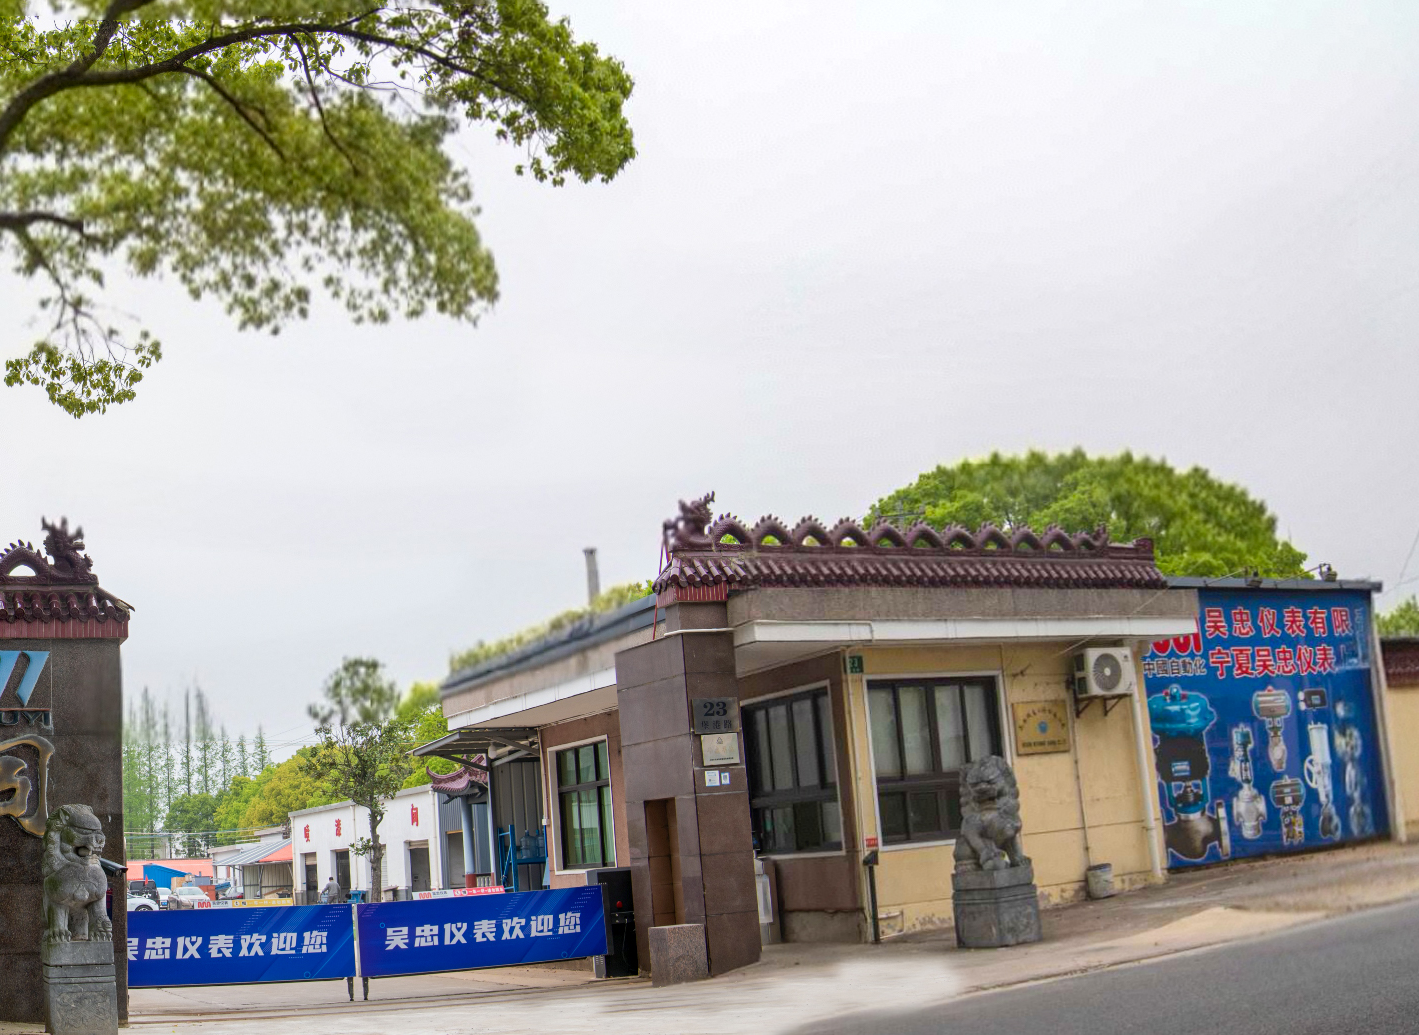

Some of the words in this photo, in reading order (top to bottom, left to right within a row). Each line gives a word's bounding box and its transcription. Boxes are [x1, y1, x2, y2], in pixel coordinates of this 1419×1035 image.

[703, 702, 728, 717] 23
[385, 911, 582, 950] 吴忠仪表欢迎您
